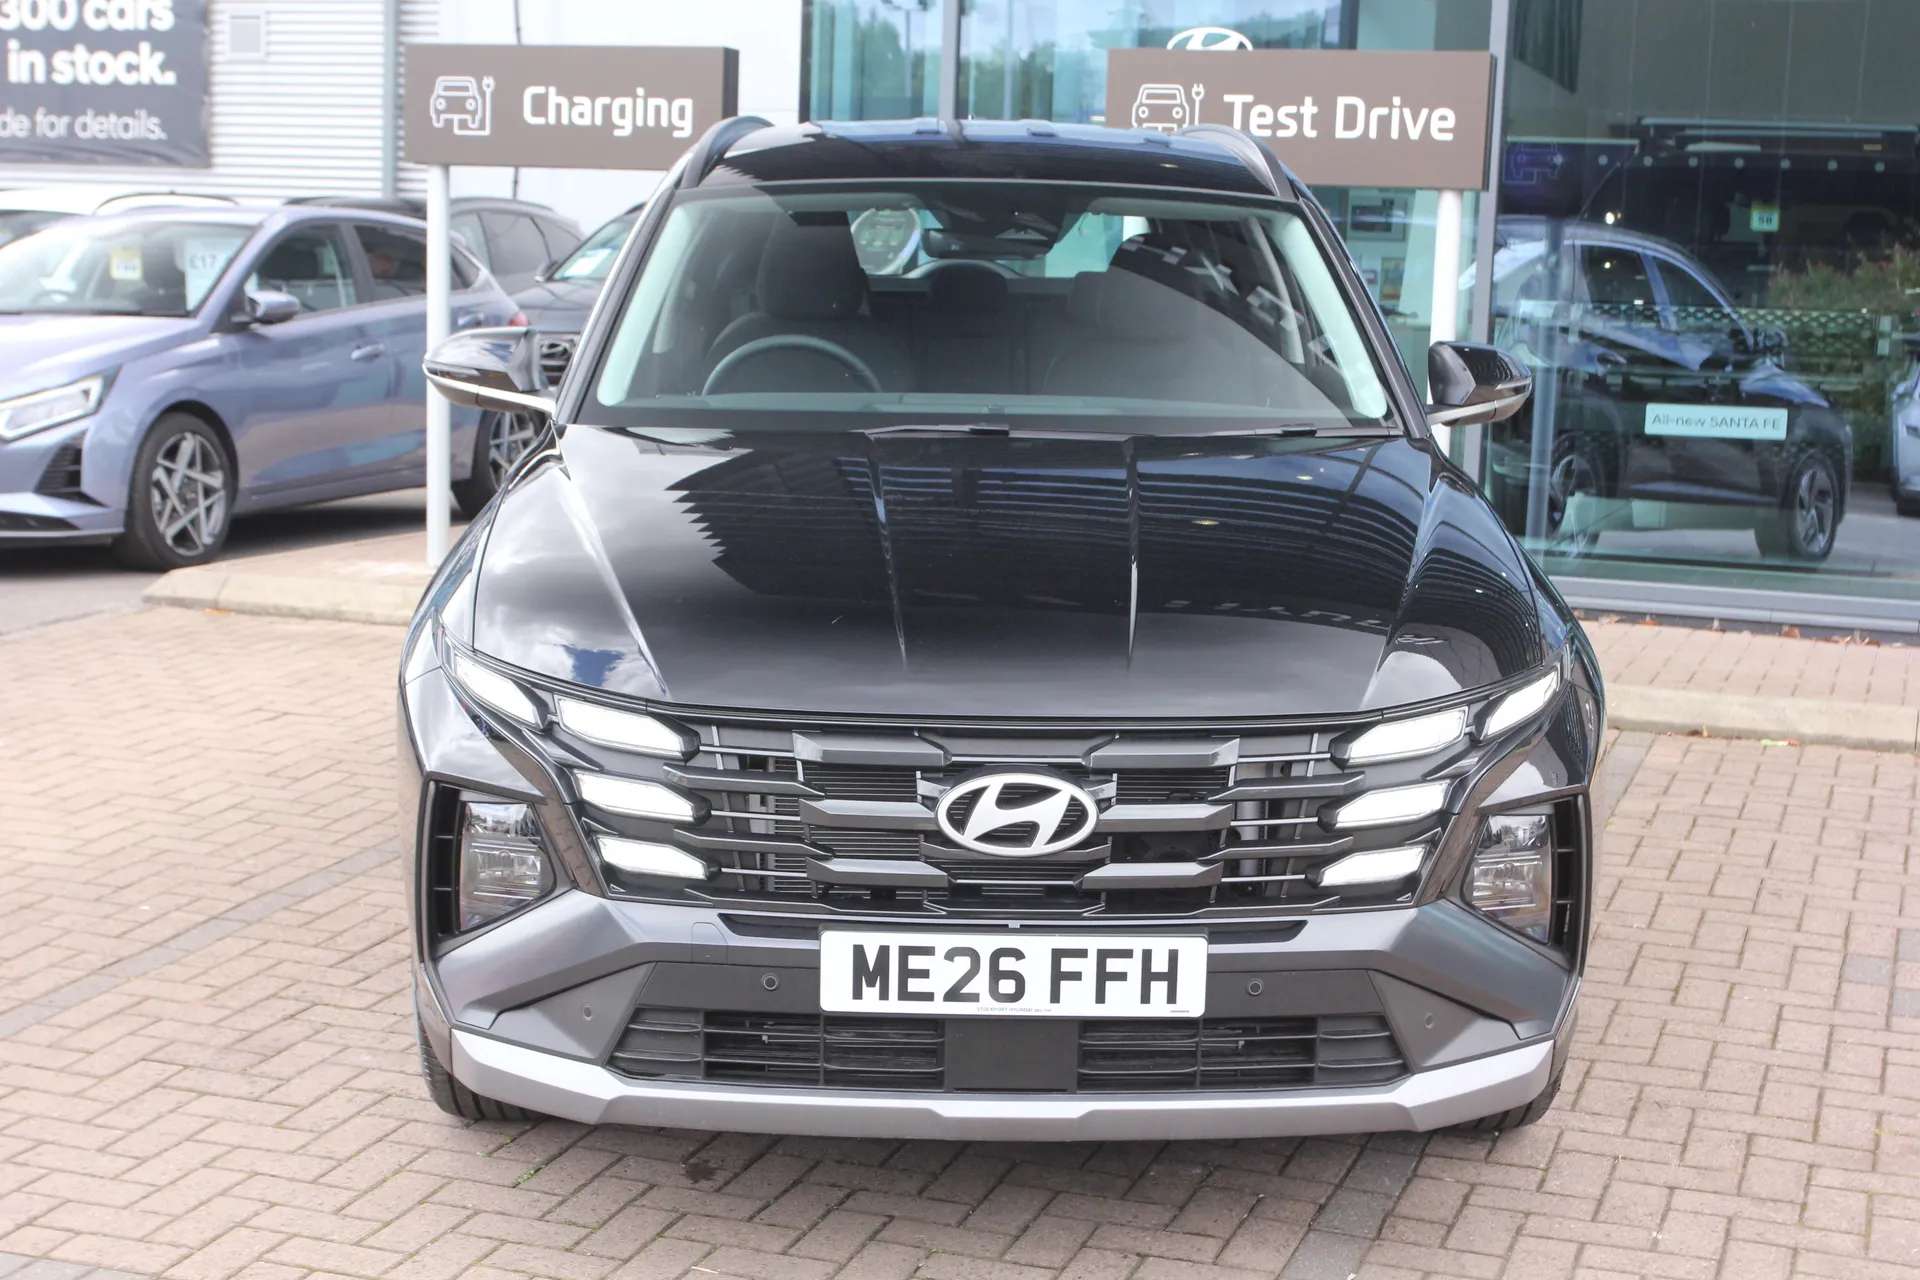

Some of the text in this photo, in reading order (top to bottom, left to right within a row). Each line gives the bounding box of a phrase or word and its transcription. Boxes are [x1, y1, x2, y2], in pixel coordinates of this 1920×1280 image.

[0, 0, 175, 31] 300 cars
[7, 38, 177, 85] in stock.
[35, 106, 71, 138] for
[74, 108, 168, 140] details.
[522, 86, 693, 138] Charging
[1223, 94, 1456, 141] Test Drive
[1652, 413, 1705, 428] All-new
[1710, 415, 1760, 431] SANTA
[852, 944, 1179, 1005] ME26 FFH
